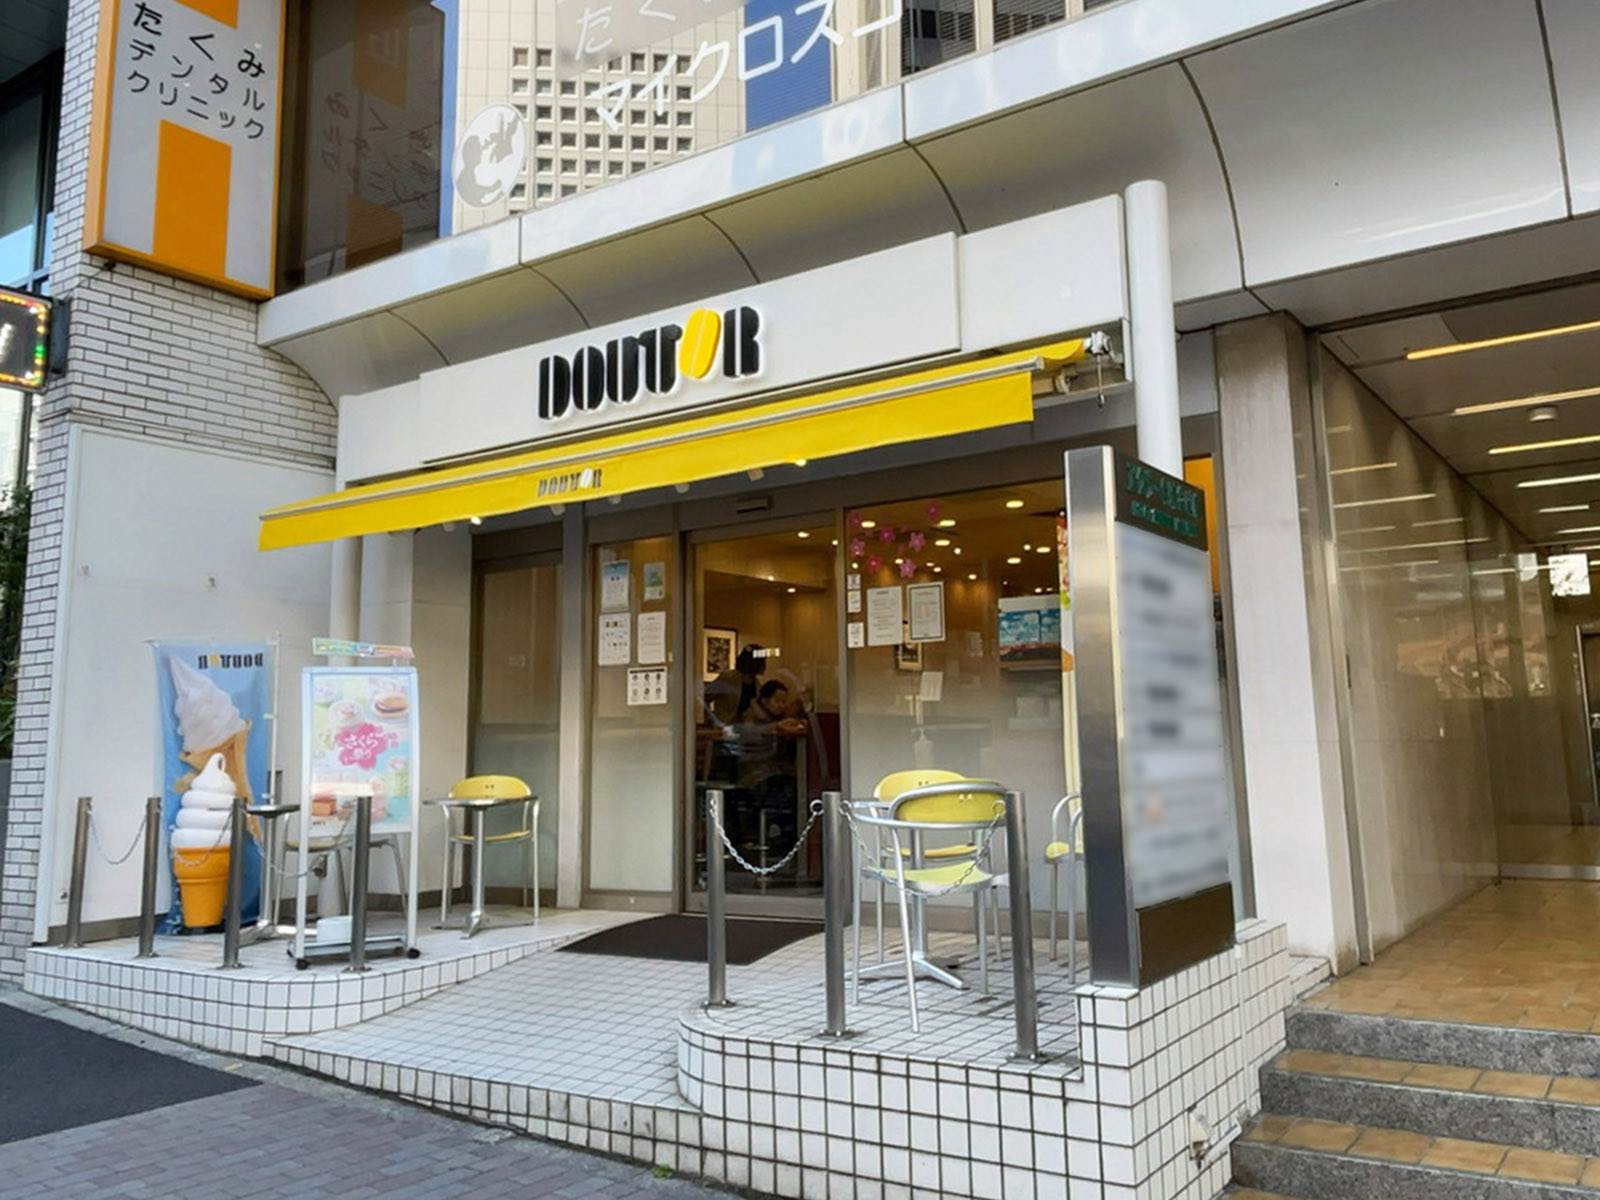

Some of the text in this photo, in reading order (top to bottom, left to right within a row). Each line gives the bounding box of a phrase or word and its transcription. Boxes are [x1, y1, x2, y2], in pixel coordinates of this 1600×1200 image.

[129, 39, 265, 111] デンタル
[133, 2, 265, 78] たくみ
[128, 70, 264, 139] クリニック
[538, 306, 760, 420] DOUTOR
[538, 467, 602, 497] DOUTOR
